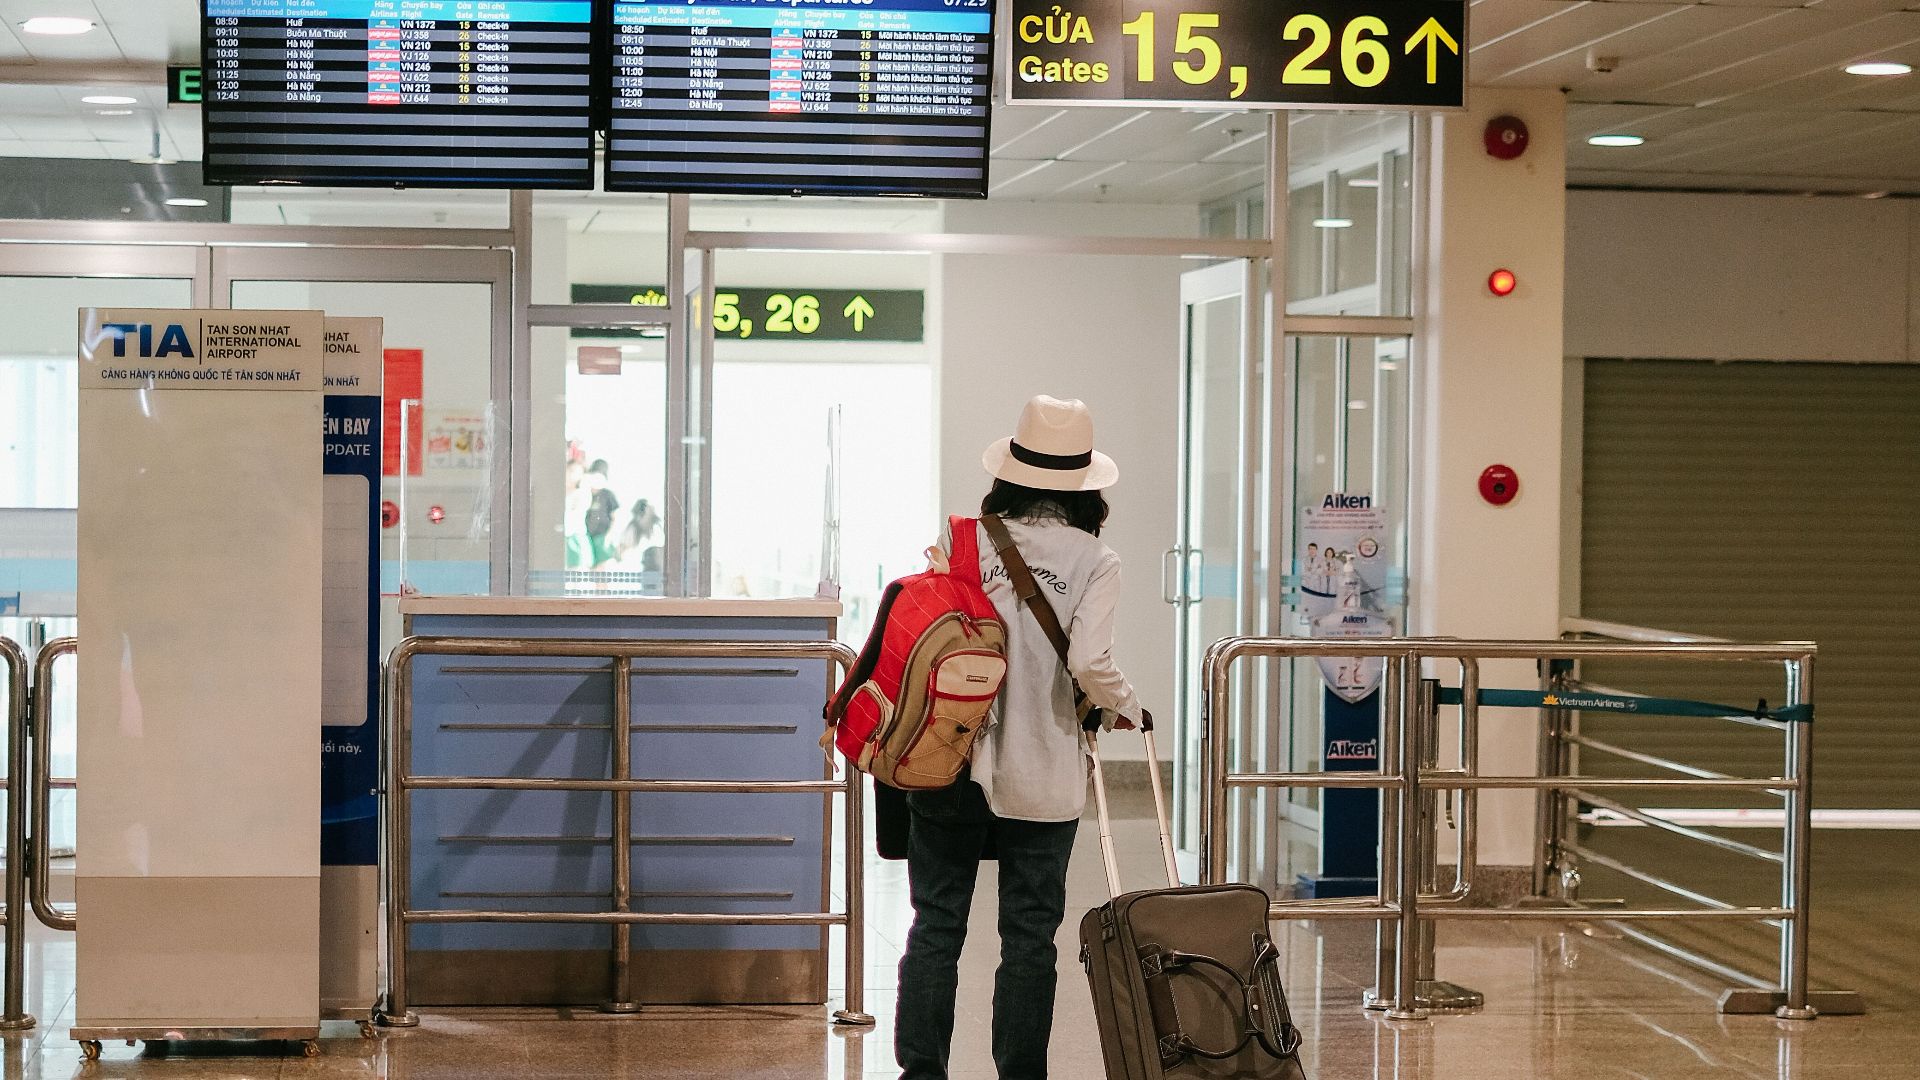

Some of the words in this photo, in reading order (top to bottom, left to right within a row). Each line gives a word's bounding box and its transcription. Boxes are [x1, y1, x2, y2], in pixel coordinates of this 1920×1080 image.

[286, 9, 328, 17] Destination
[401, 11, 422, 19] Flight
[216, 18, 238, 26] 08:50
[401, 21, 414, 29] VN
[415, 21, 435, 29] 1372
[477, 22, 509, 30] Check-in
[1018, 6, 1094, 44] CỬA
[309, 30, 322, 38] Ma
[324, 30, 347, 38] Thuột
[459, 32, 470, 40] 26
[477, 32, 509, 40] Check-in
[622, 26, 644, 34] 08:50
[804, 30, 816, 38] VN
[818, 30, 838, 38] 1372
[861, 31, 871, 39] 15
[216, 39, 238, 47] 10:00
[286, 40, 298, 48] Hà
[300, 40, 314, 49] Nội
[401, 42, 414, 50] VN
[415, 42, 431, 50] 210
[477, 43, 509, 51] Check-in
[622, 36, 644, 44] 09:10
[804, 40, 814, 48] VJ
[860, 41, 871, 49] 26
[286, 50, 298, 58] Hà
[300, 50, 314, 60] Nội
[477, 54, 509, 62] Check-in
[621, 47, 644, 55] 10:00
[817, 51, 832, 59] 210
[860, 52, 870, 60] 15
[1122, 11, 1248, 99] 15,
[1282, 14, 1390, 88] 26
[216, 60, 238, 68] 11:00
[300, 61, 314, 70] Nội
[459, 64, 470, 72] 15
[477, 64, 509, 72] Check-in
[621, 57, 643, 65] 10:05
[803, 61, 813, 69] VJ
[860, 62, 870, 70] 26
[621, 68, 643, 76] 11:00
[816, 72, 831, 80] 246
[859, 73, 870, 81] 15
[1018, 56, 1109, 84] Gates
[216, 71, 238, 79] 11:25
[286, 72, 298, 80] Đà
[401, 74, 412, 82] VJ
[414, 74, 429, 82] 622
[477, 75, 509, 83] Check-in
[180, 70, 202, 100] E
[286, 82, 298, 90] Hà
[300, 82, 314, 91] Nội
[459, 85, 470, 93] 15
[477, 85, 509, 93] Check-in
[621, 78, 643, 86] 11:25
[802, 82, 813, 90] VJ
[815, 82, 829, 90] 622
[216, 92, 239, 100] 12:45
[401, 95, 412, 103] VJ
[414, 95, 428, 103] 644
[477, 96, 509, 104] Check-in
[621, 89, 643, 97] 12:00
[802, 92, 814, 100] VN
[815, 93, 831, 101] 212
[858, 94, 869, 102] 15
[620, 99, 643, 107] 12:45
[802, 103, 812, 111] VJ
[814, 103, 828, 111] 644
[858, 104, 868, 112] 26
[766, 294, 820, 334] 26
[207, 325, 229, 334] TAN
[233, 325, 256, 335] SON
[260, 326, 290, 335] NHAT
[102, 324, 194, 358] TIA
[207, 337, 301, 347] INTERNATIONAL
[207, 349, 257, 358] AIRPORT
[325, 344, 360, 353] IONAL
[158, 368, 190, 379] KHÔNG
[193, 368, 218, 380] QUỐC
[221, 368, 232, 380] TẾ
[235, 369, 252, 380] TÂN
[256, 370, 274, 380] SƠN
[277, 369, 300, 380] NHẤT
[336, 375, 360, 386] NHẤT
[343, 417, 370, 435] BAY
[326, 444, 371, 456] PDATE
[1323, 494, 1370, 508] Aiken
[1342, 615, 1368, 623] Aiken
[1328, 742, 1375, 756] Aiken
